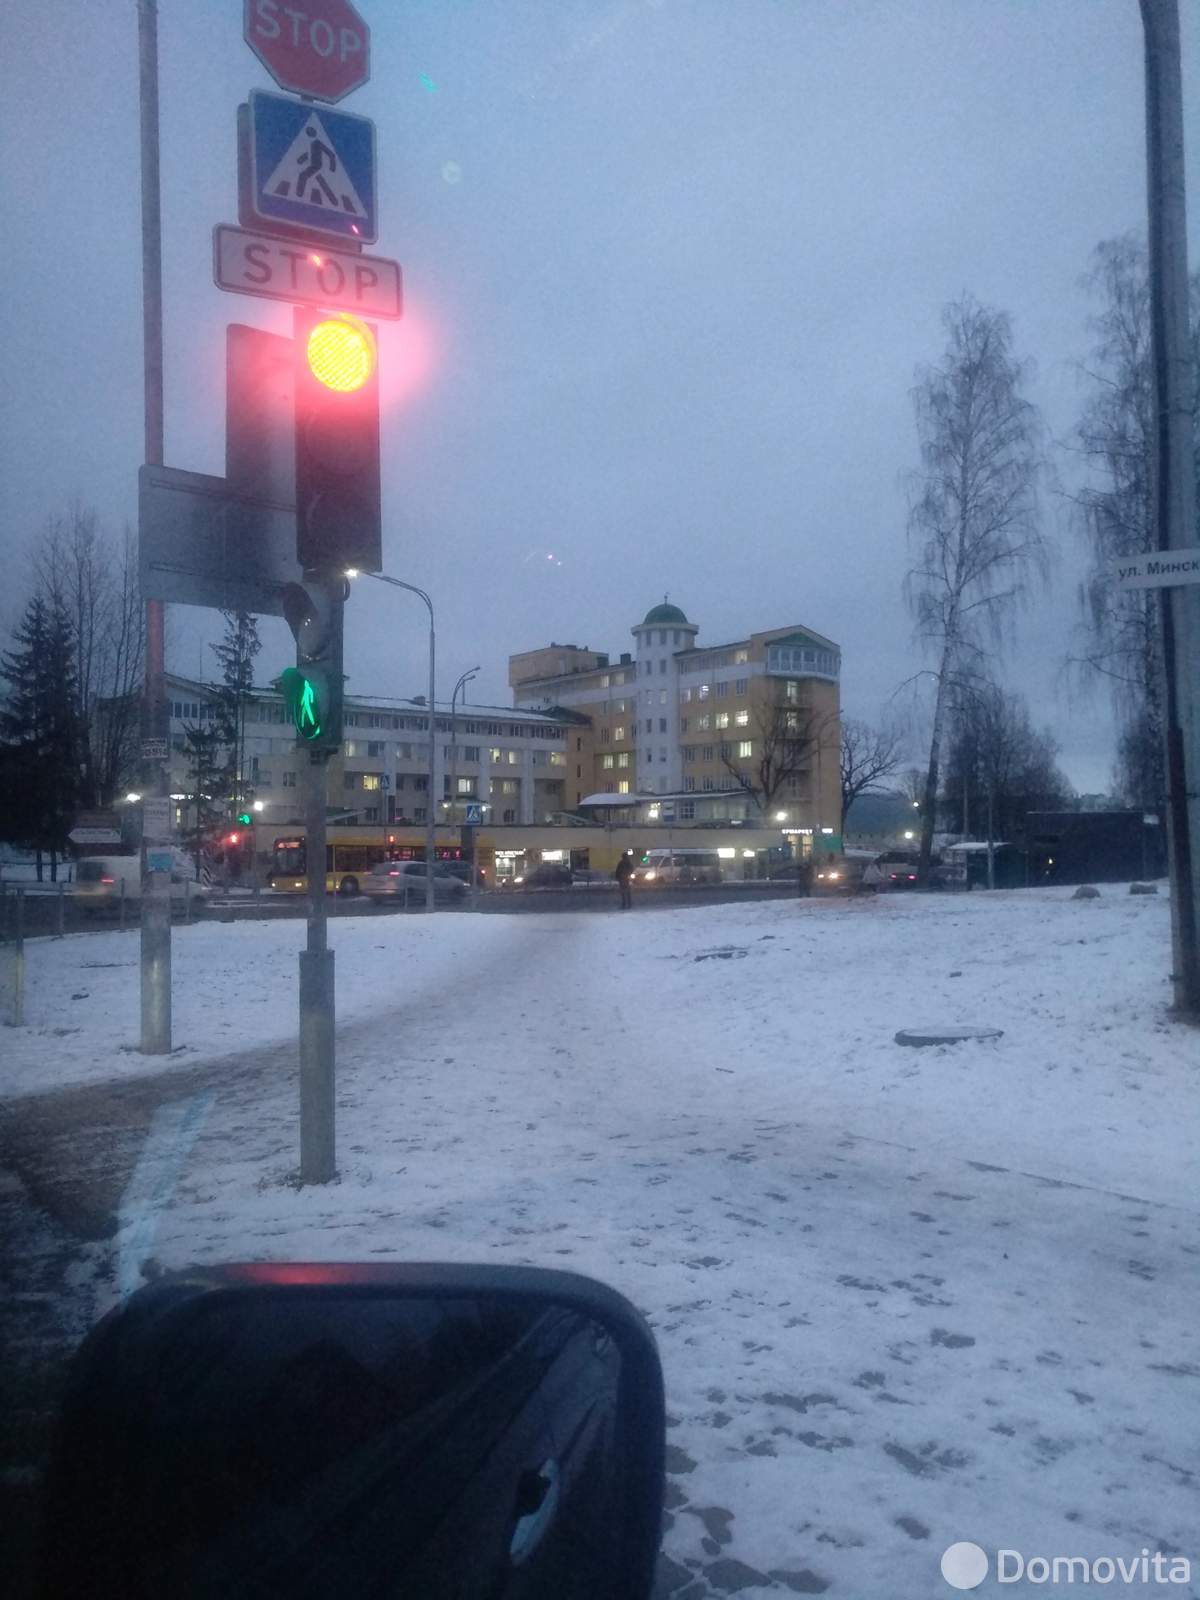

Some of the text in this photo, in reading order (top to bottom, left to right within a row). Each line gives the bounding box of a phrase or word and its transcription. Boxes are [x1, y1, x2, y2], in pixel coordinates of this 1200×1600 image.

[255, 0, 361, 62] STOP
[243, 243, 379, 302] STOP
[1118, 566, 1141, 582] ул.
